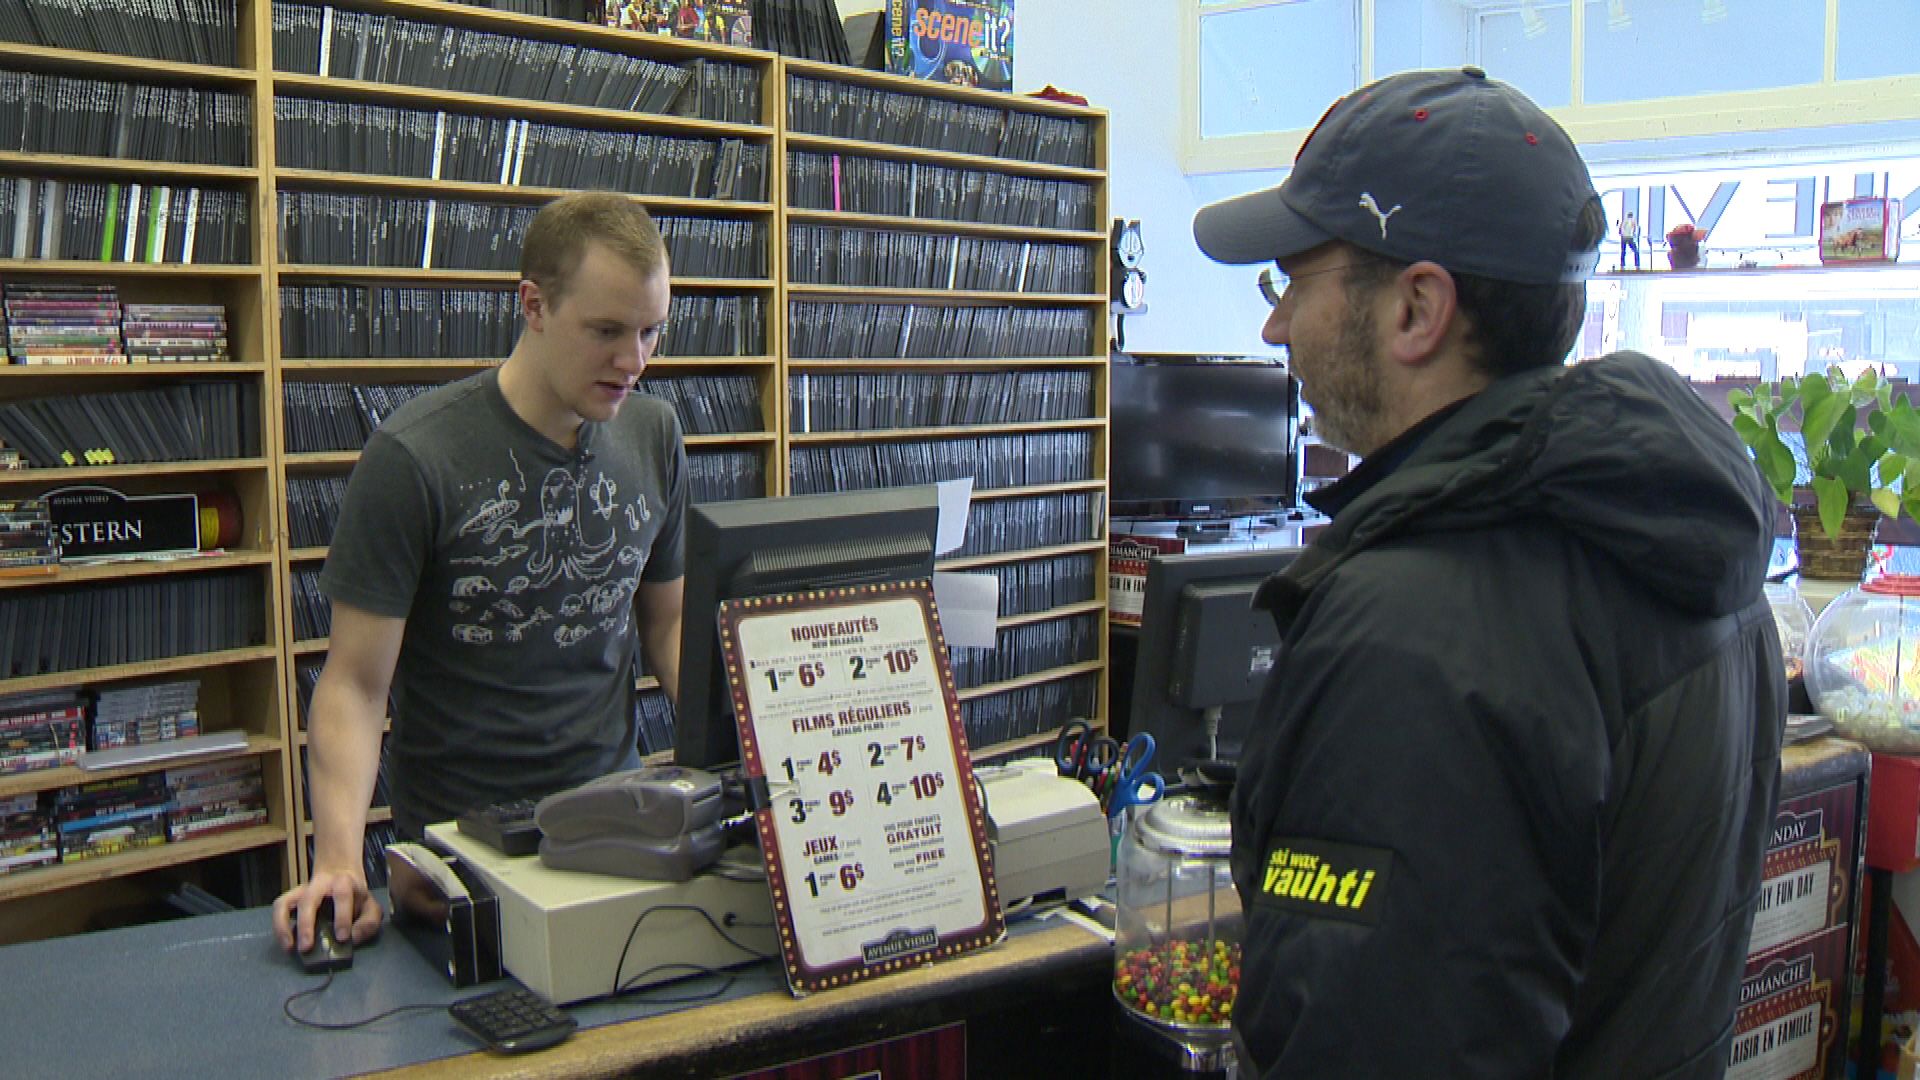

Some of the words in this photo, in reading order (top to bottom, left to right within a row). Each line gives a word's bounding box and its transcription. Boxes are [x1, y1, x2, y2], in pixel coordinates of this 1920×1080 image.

[914, 7, 982, 49] scene
[984, 11, 1010, 54] it?
[791, 616, 879, 643] NOUVEAUTÉS
[764, 667, 778, 693] 1
[798, 661, 825, 687] 6$
[849, 655, 867, 680] 2
[883, 647, 919, 675] 10$
[792, 713, 835, 735] FILMS
[838, 700, 911, 726] RÉGULIERS
[781, 756, 795, 782] 1
[817, 750, 842, 777] 4$
[867, 742, 885, 768] 2
[900, 735, 926, 762] 7$
[876, 781, 892, 806] 4
[909, 771, 944, 800] 10$
[789, 797, 806, 824] 3
[829, 789, 854, 816] 9$
[803, 836, 839, 857] JEUX
[886, 823, 941, 845] GRATUIT
[814, 853, 839, 865] GAMES
[916, 848, 945, 864] FREE
[1269, 848, 1290, 866] ski
[1290, 853, 1320, 871] wax
[805, 872, 819, 897] 1
[840, 862, 865, 890] 6$
[1262, 863, 1376, 909] vauhti
[1776, 878, 1794, 906] FUN
[1797, 872, 1814, 898] DAY
[904, 933, 935, 951] VIDEO
[1741, 962, 1805, 1003] DIMANCHE
[1762, 1026, 1775, 1053] EN
[1777, 1010, 1813, 1047] FAMILLE
